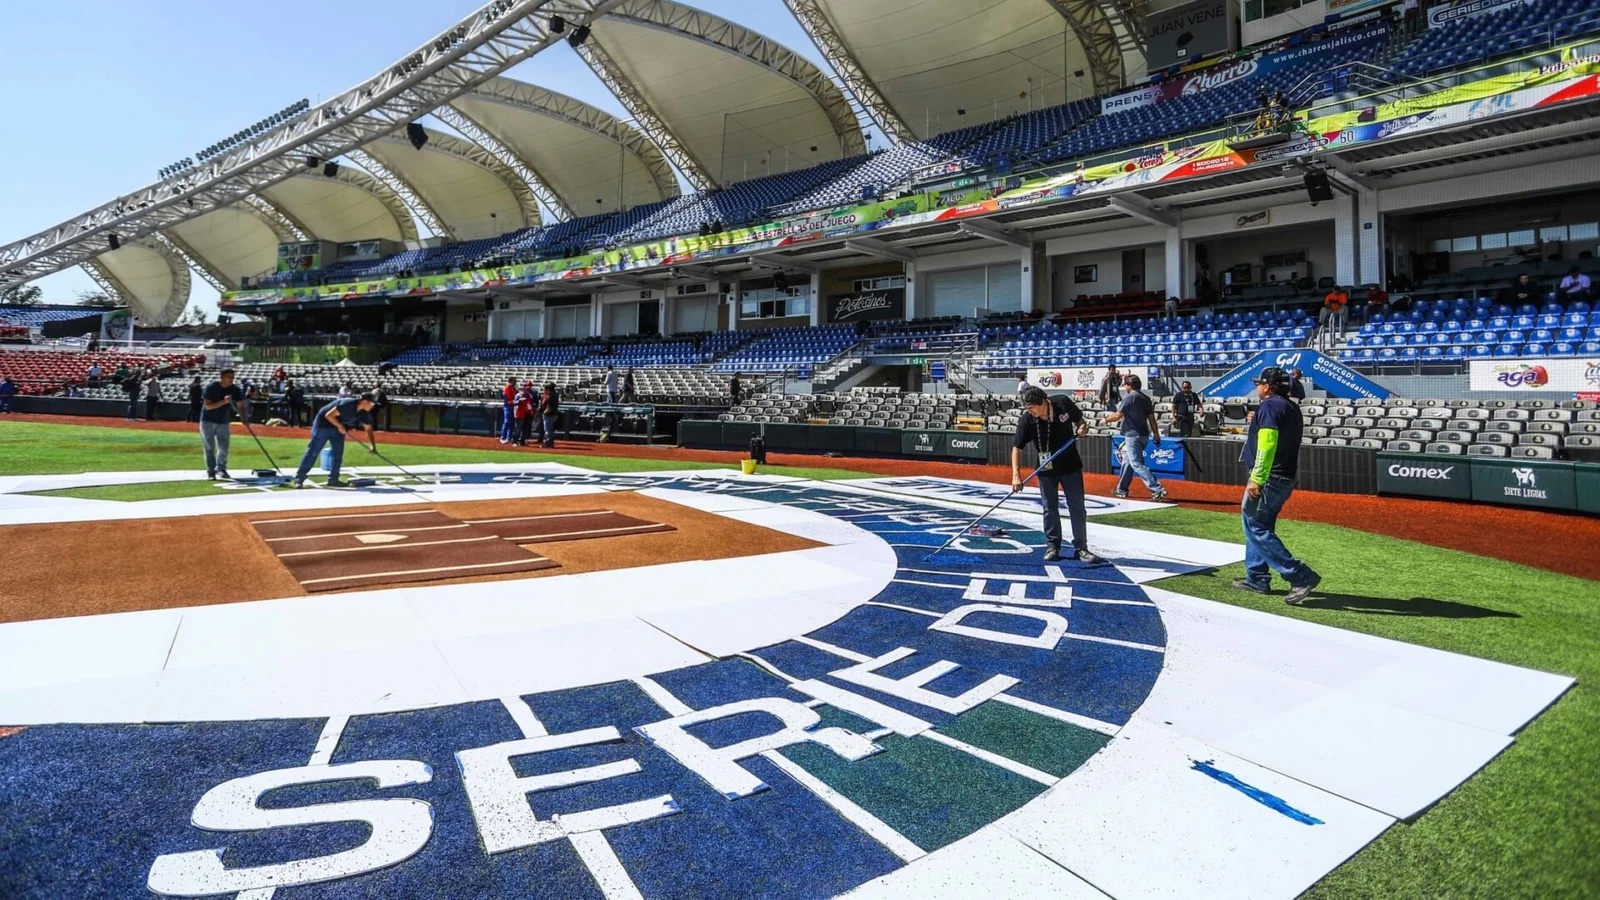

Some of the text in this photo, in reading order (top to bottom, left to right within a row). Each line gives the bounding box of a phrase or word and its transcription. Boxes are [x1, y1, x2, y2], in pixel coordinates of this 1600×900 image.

[1149, 17, 1185, 38] JUAN
[1187, 5, 1225, 25] VENÉ
[1272, 25, 1387, 64] www.charrosjalisco.com
[1182, 58, 1259, 97] Charros
[1104, 87, 1164, 111] PRENSA
[1340, 130, 1354, 144] 60
[1377, 115, 1419, 138] Jalisco
[763, 222, 808, 239] ESTRELLAS
[809, 220, 825, 232] DEL
[826, 214, 857, 229] JUEGO
[834, 292, 891, 320] Potosinos
[1497, 371, 1538, 388] aga
[951, 439, 981, 449] Comex
[1387, 464, 1455, 480] Comex
[1503, 486, 1546, 499] SIETE LEGUAS
[146, 646, 1021, 897] SERIE
[927, 564, 1073, 652] DEL
